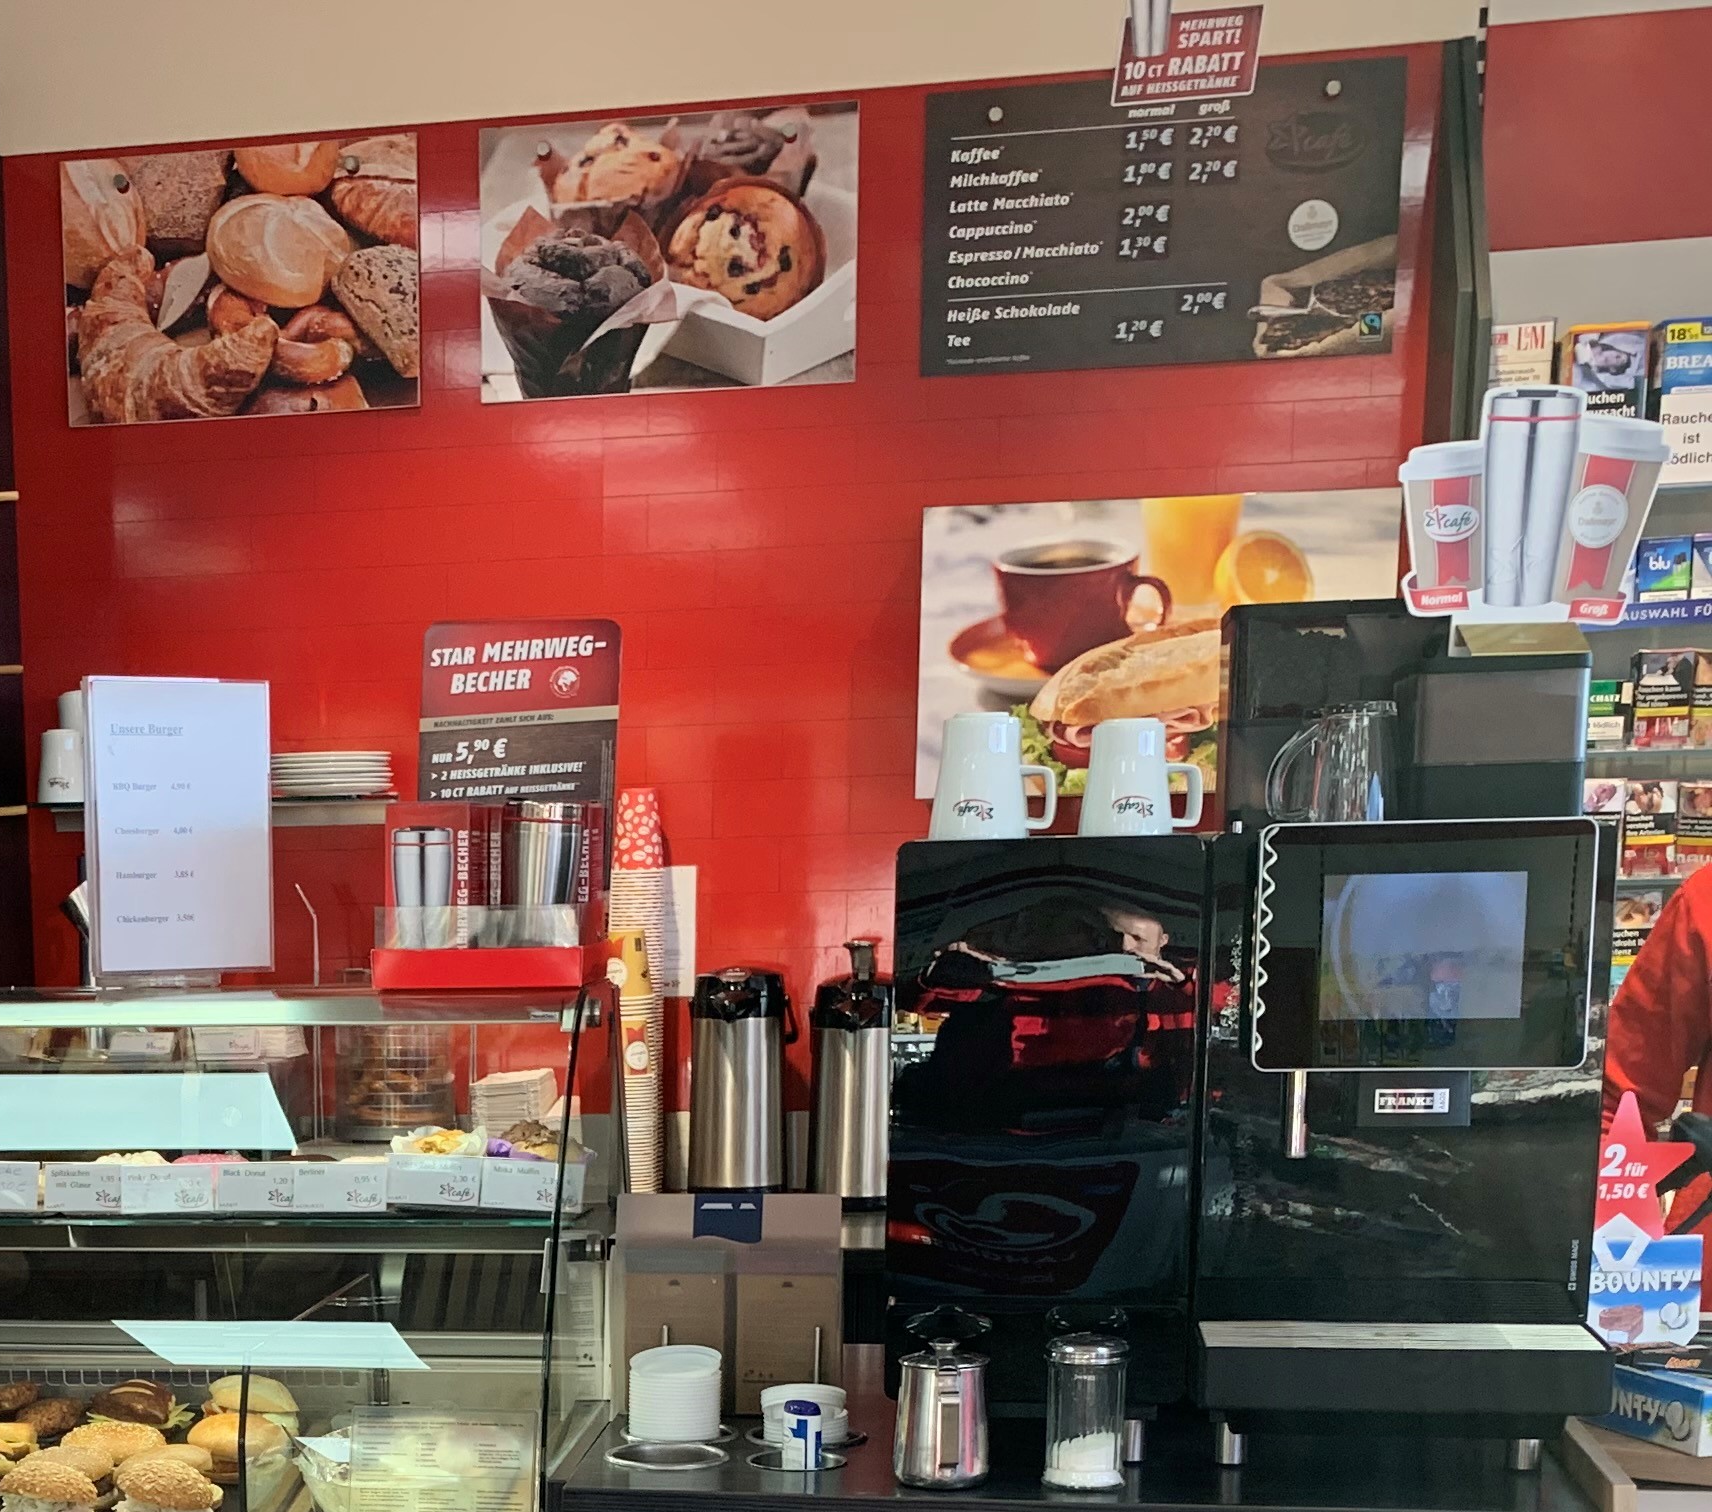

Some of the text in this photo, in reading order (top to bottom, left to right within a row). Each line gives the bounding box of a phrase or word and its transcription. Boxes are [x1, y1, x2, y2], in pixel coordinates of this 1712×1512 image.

[1179, 15, 1244, 32] MEHRWEG
[1177, 28, 1241, 49] SPART!
[1124, 51, 1245, 81] 10 CT RABATT
[1121, 84, 1143, 97] AUF
[1128, 100, 1231, 118] normal groß
[949, 200, 988, 213] Latte
[947, 307, 990, 324] Heiße
[994, 302, 1081, 319] Schokolade
[947, 335, 971, 347] Tee
[1666, 354, 1712, 369] BREA
[1588, 391, 1625, 404] uchen
[1662, 412, 1712, 424] Rauche
[1683, 432, 1700, 444] ist
[1669, 452, 1712, 465] ödlich
[1444, 511, 1473, 532] café
[1649, 556, 1671, 571] blu
[1420, 592, 1463, 606] Normal
[1579, 603, 1609, 616] Groß
[1622, 604, 1712, 621] AUSWAHL FÜ
[430, 634, 607, 667] STAR MEHRWEG-
[450, 668, 532, 695] BECHER
[110, 723, 184, 737] Unsere Burger
[431, 753, 453, 764] NUR
[449, 764, 527, 781] HEISSGETRÄNKE
[466, 784, 505, 797] RABATT
[115, 871, 157, 880] Hamburger
[490, 831, 502, 910] EG-BECHER
[1378, 1096, 1434, 1106] FRANKE
[1600, 1144, 1648, 1177] 2 für
[223, 1169, 240, 1177] Black
[298, 1168, 325, 1176] Berliner
[1590, 1270, 1694, 1294] BOUNTY
[1611, 1388, 1661, 1426] NTY
